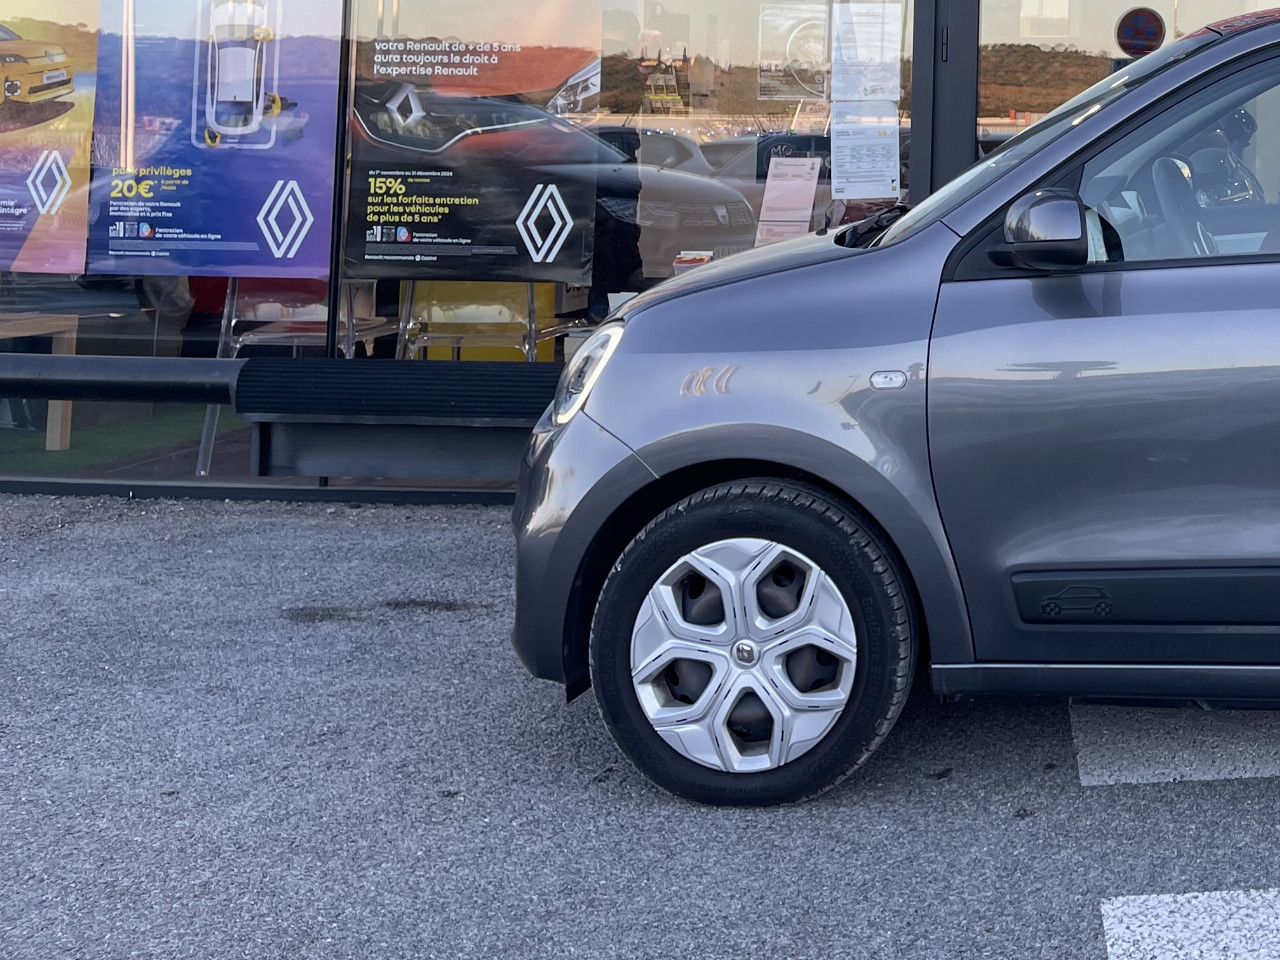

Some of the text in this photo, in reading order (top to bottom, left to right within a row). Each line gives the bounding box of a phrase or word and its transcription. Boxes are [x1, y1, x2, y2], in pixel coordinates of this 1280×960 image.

[375, 42, 404, 50] votre
[406, 41, 450, 51] Renault
[452, 42, 466, 51] de
[476, 43, 491, 51] de
[493, 43, 499, 52] 5
[501, 44, 521, 52] ans
[374, 54, 498, 65] aura toujours le droit à
[434, 66, 478, 76] Renault
[139, 166, 192, 178] privilèges
[368, 178, 406, 194] 15%
[384, 195, 397, 203] les
[399, 195, 434, 204] forfaits
[435, 196, 479, 205] entretien
[390, 204, 403, 213] les
[405, 205, 449, 213] véhicules
[367, 214, 379, 222] de
[380, 214, 399, 223] plus
[401, 214, 413, 222] de
